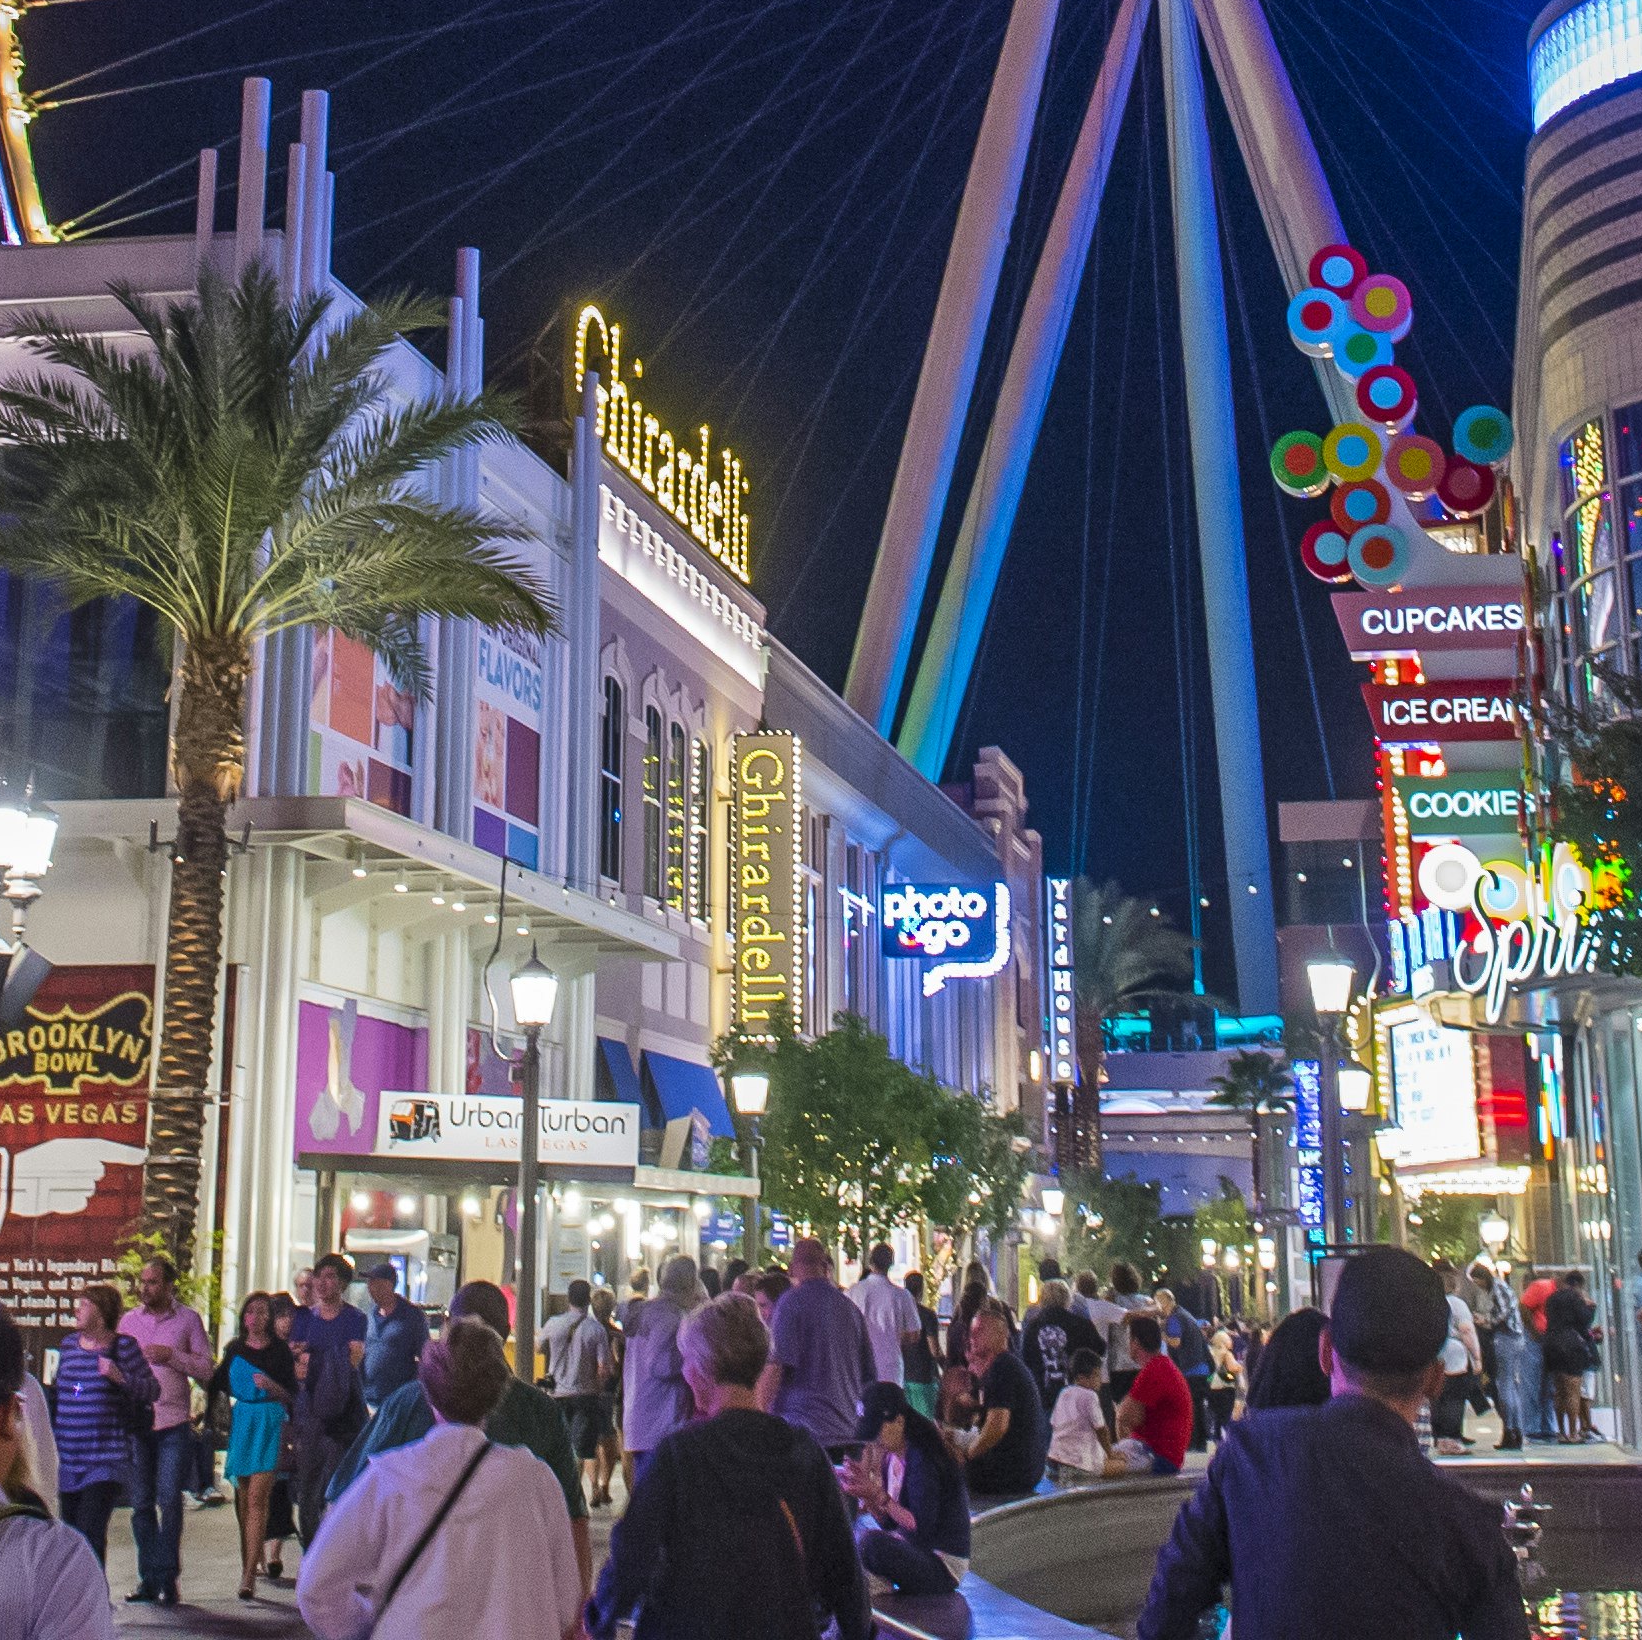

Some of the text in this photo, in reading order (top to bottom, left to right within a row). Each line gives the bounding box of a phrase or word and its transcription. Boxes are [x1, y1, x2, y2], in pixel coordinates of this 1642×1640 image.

[575, 304, 751, 584] Ghirardelli
[1361, 604, 1523, 635] CUPCAKES
[478, 637, 541, 711] FLAVORS
[1382, 699, 1428, 725] ICE
[740, 748, 787, 1023] Ghirardelli
[883, 885, 988, 927] photo
[1051, 879, 1072, 1079] Yard House
[34, 1052, 100, 1074] BOWL
[44, 1103, 139, 1125] VEGAS
[485, 1136, 588, 1151] LAS EGAS
